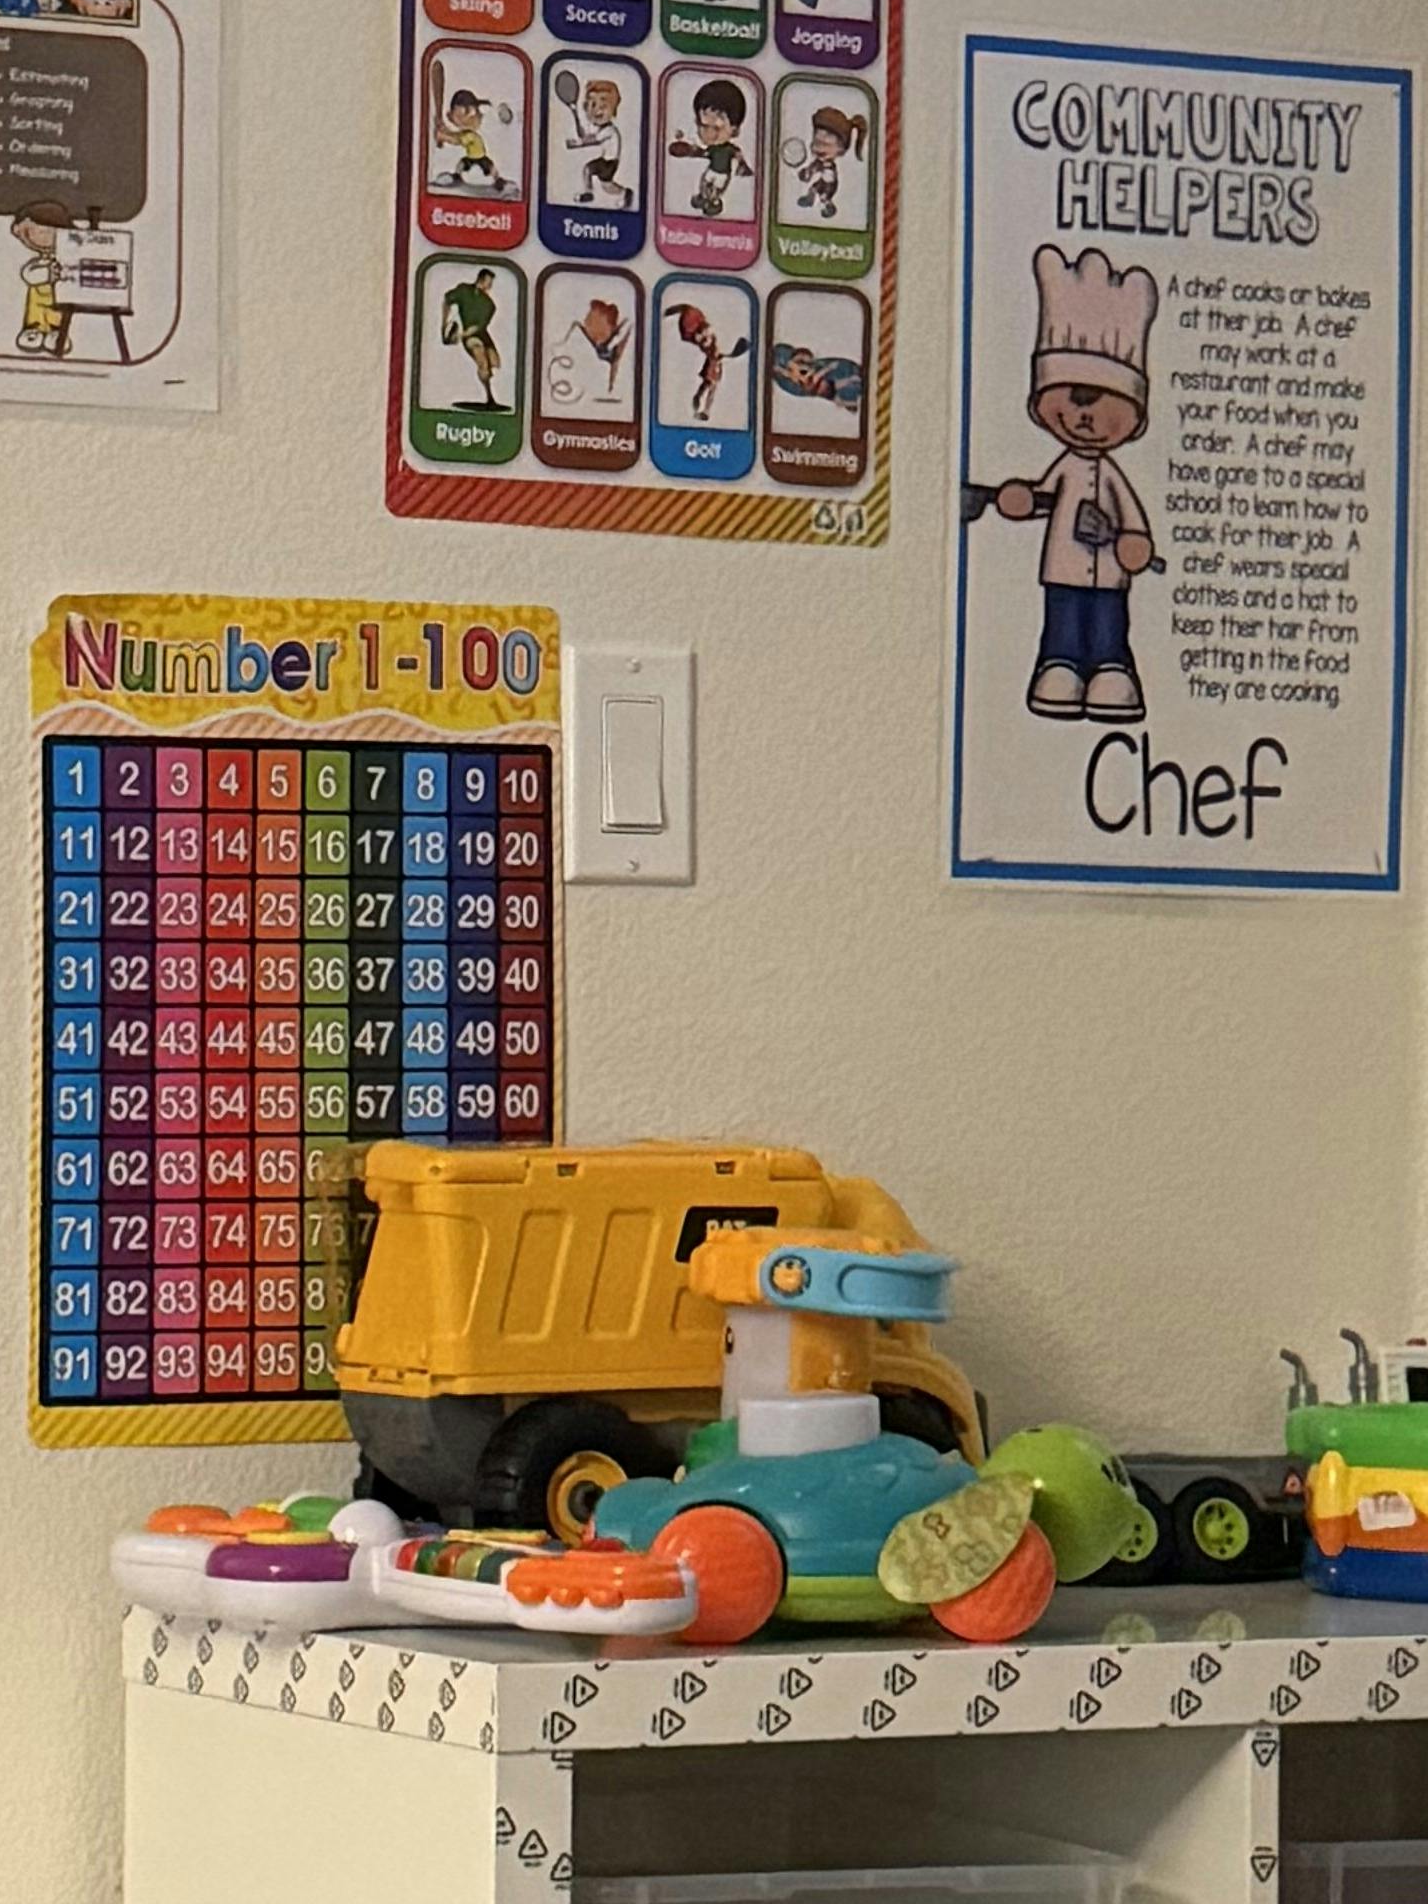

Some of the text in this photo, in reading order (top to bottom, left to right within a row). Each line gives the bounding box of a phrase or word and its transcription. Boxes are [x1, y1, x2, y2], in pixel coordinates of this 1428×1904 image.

[565, 3, 627, 27] Soccer
[669, 14, 761, 40] Basketball
[791, 26, 862, 55] Jogging
[1012, 79, 1363, 173] COMMUNITY
[1056, 158, 1321, 247] HELPERS
[431, 207, 512, 232] Baseball
[563, 218, 619, 241] Tennis
[777, 237, 865, 262] Volleyball
[1184, 277, 1226, 299] chef
[1232, 281, 1285, 304] cooks
[1200, 343, 1291, 368] may work
[1172, 371, 1365, 400] restaurant and make
[1177, 399, 1358, 436] your food when you
[435, 423, 497, 449] Rugby
[542, 428, 636, 453] Gymnastics
[685, 440, 723, 460] Golf
[1264, 434, 1307, 457] chef
[1313, 441, 1354, 466] may
[771, 446, 860, 471] Swimming
[1169, 458, 1210, 483] have
[1166, 489, 1341, 521] school how
[1230, 560, 1285, 579] wears
[1173, 582, 1277, 610] clothes and
[1308, 619, 1359, 644] from
[63, 619, 543, 696] Number 1-100
[1180, 647, 1350, 674] getting the food
[68, 760, 538, 803] 1 2 3 4 5 6 7 8 9 10
[1084, 730, 1288, 841] Chef
[60, 826, 539, 866] 11 12 13 14 15 16 17 18 19 20
[59, 890, 539, 929] 21 22 23 24 25 26 27 28 29 30
[59, 956, 539, 992] 31 32 33 34 35 36 37 38 39 40
[56, 1020, 540, 1056] 41 42 43 44 45 46 47 48 49 50
[59, 1084, 539, 1121] 51 52 53 54 55 56 57 58 59 60
